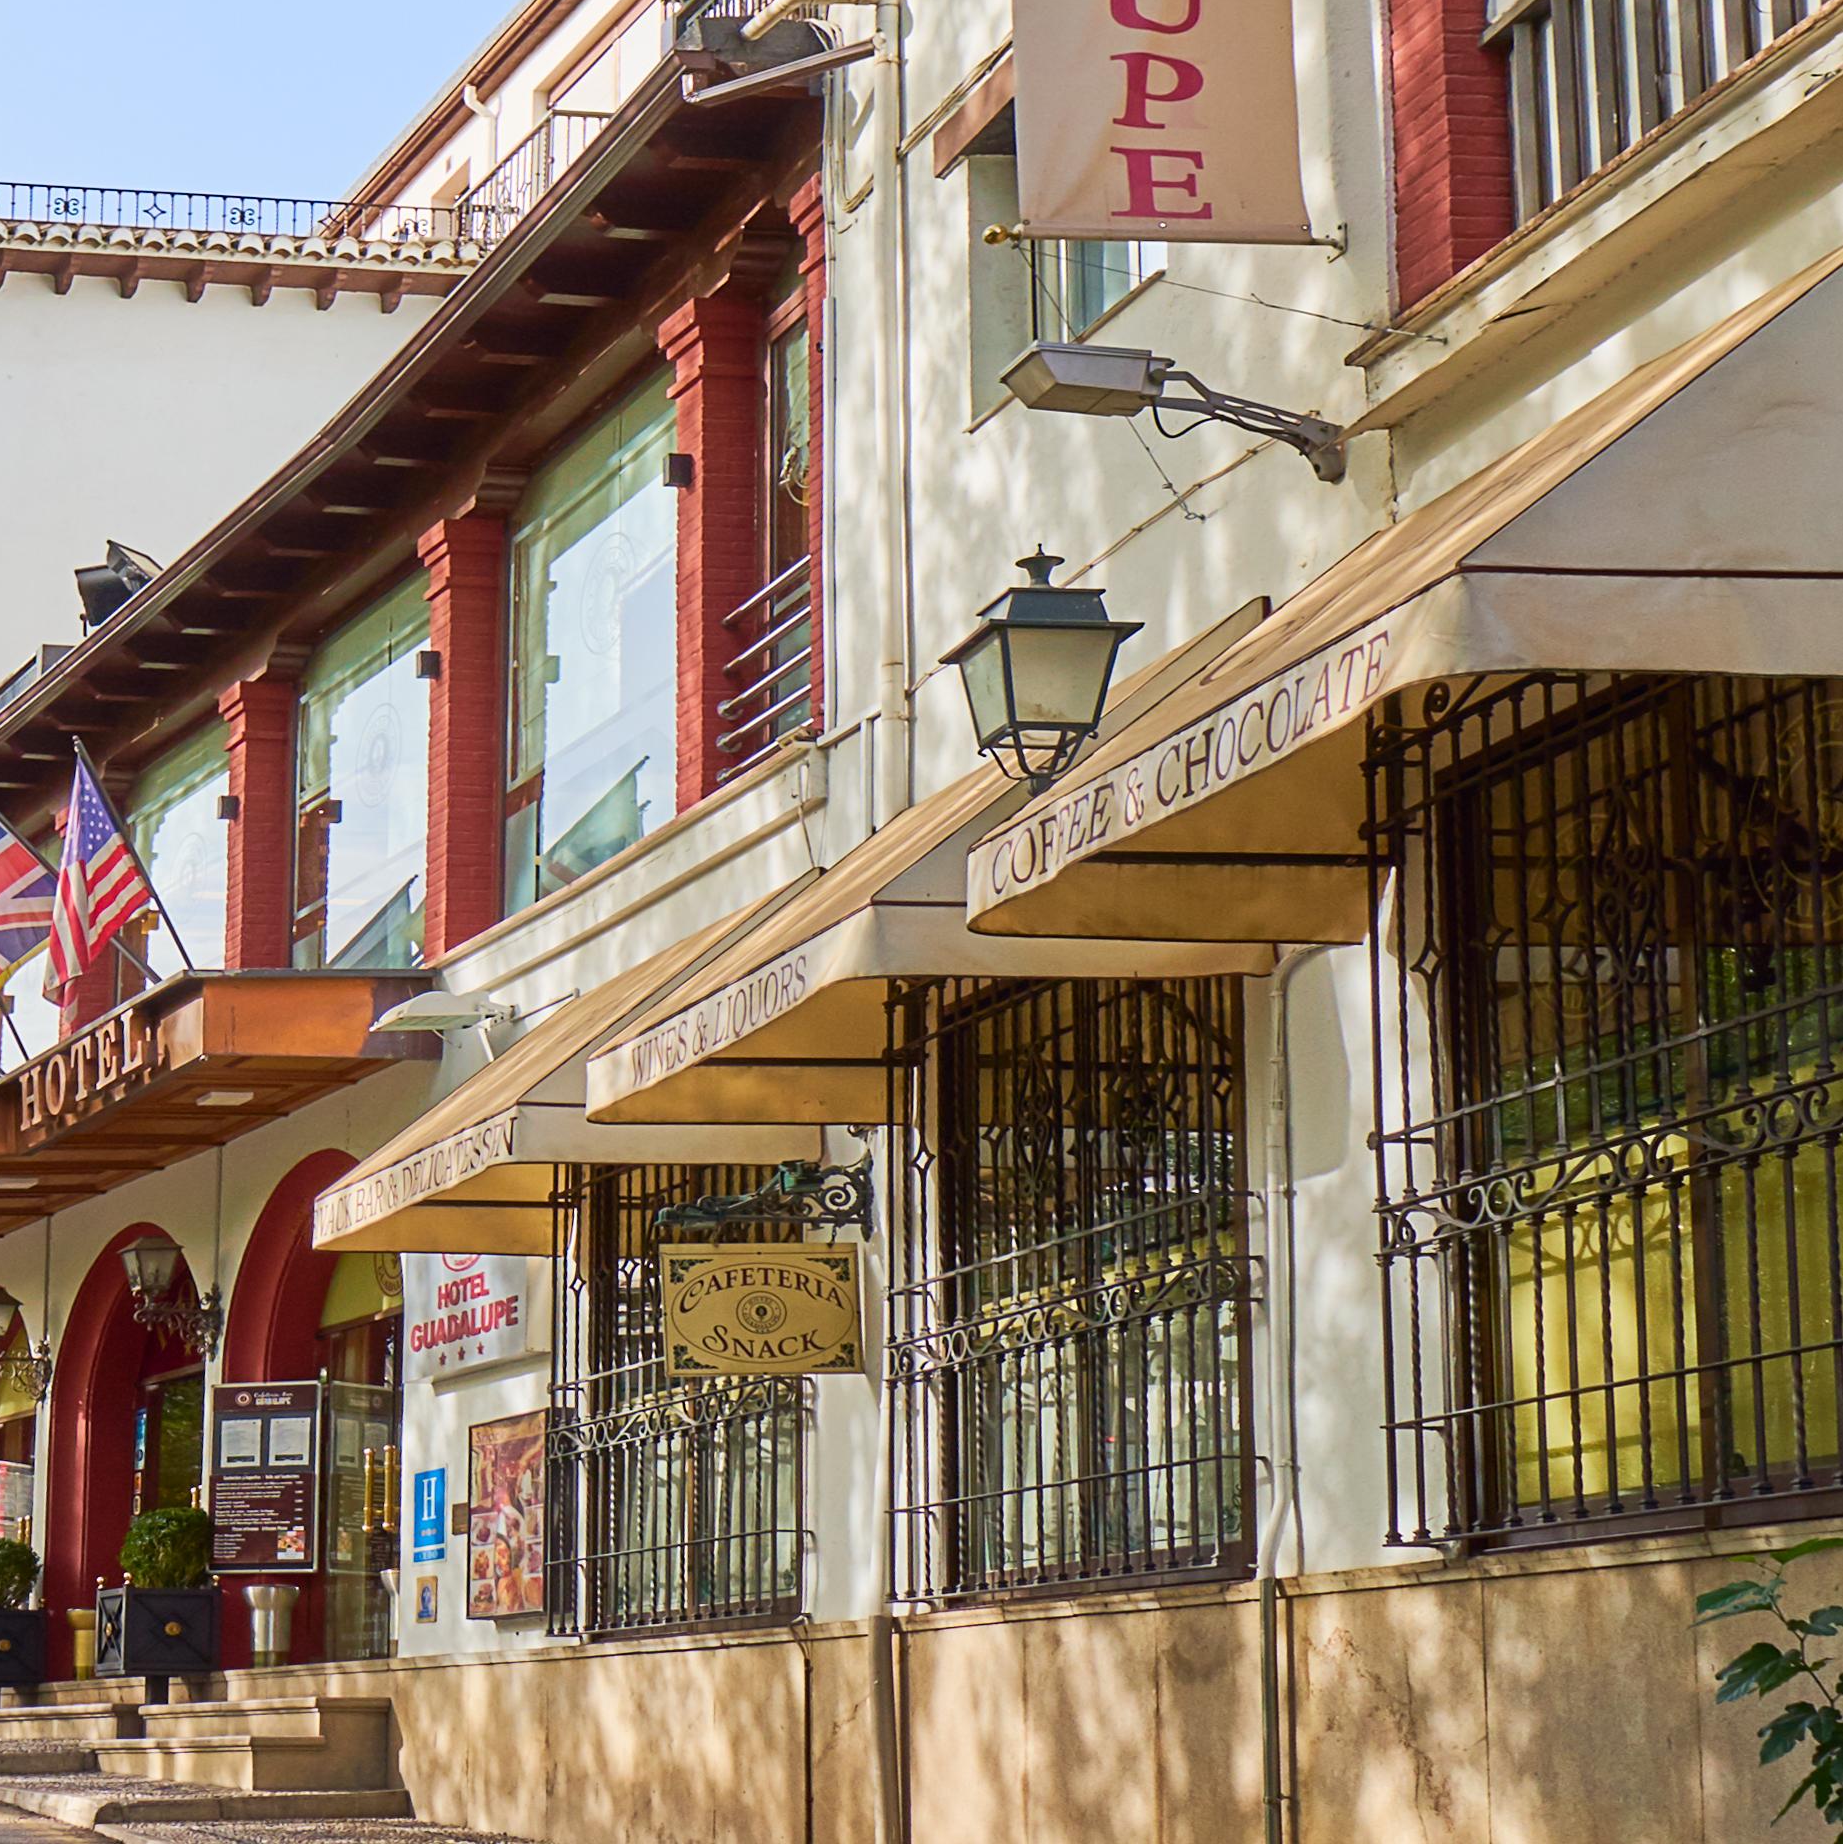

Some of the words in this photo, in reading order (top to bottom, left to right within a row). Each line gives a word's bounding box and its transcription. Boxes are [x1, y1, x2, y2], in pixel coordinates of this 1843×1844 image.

[992, 783, 1115, 895] COFFEE
[1124, 767, 1145, 826] &
[1156, 630, 1391, 808] CHOCOLATE
[630, 1020, 689, 1088] WINES
[692, 1011, 708, 1057] &
[712, 955, 808, 1047] LIQUORS
[20, 1008, 144, 1133] HOTEL
[355, 1179, 384, 1223] BAR
[387, 1172, 399, 1210] &
[437, 1272, 490, 1310] HOTEL
[679, 1267, 846, 1314] CAFETERIA
[410, 1294, 520, 1353] GUADALUPE
[702, 1323, 827, 1359] SNACK
[421, 1477, 437, 1521] H
